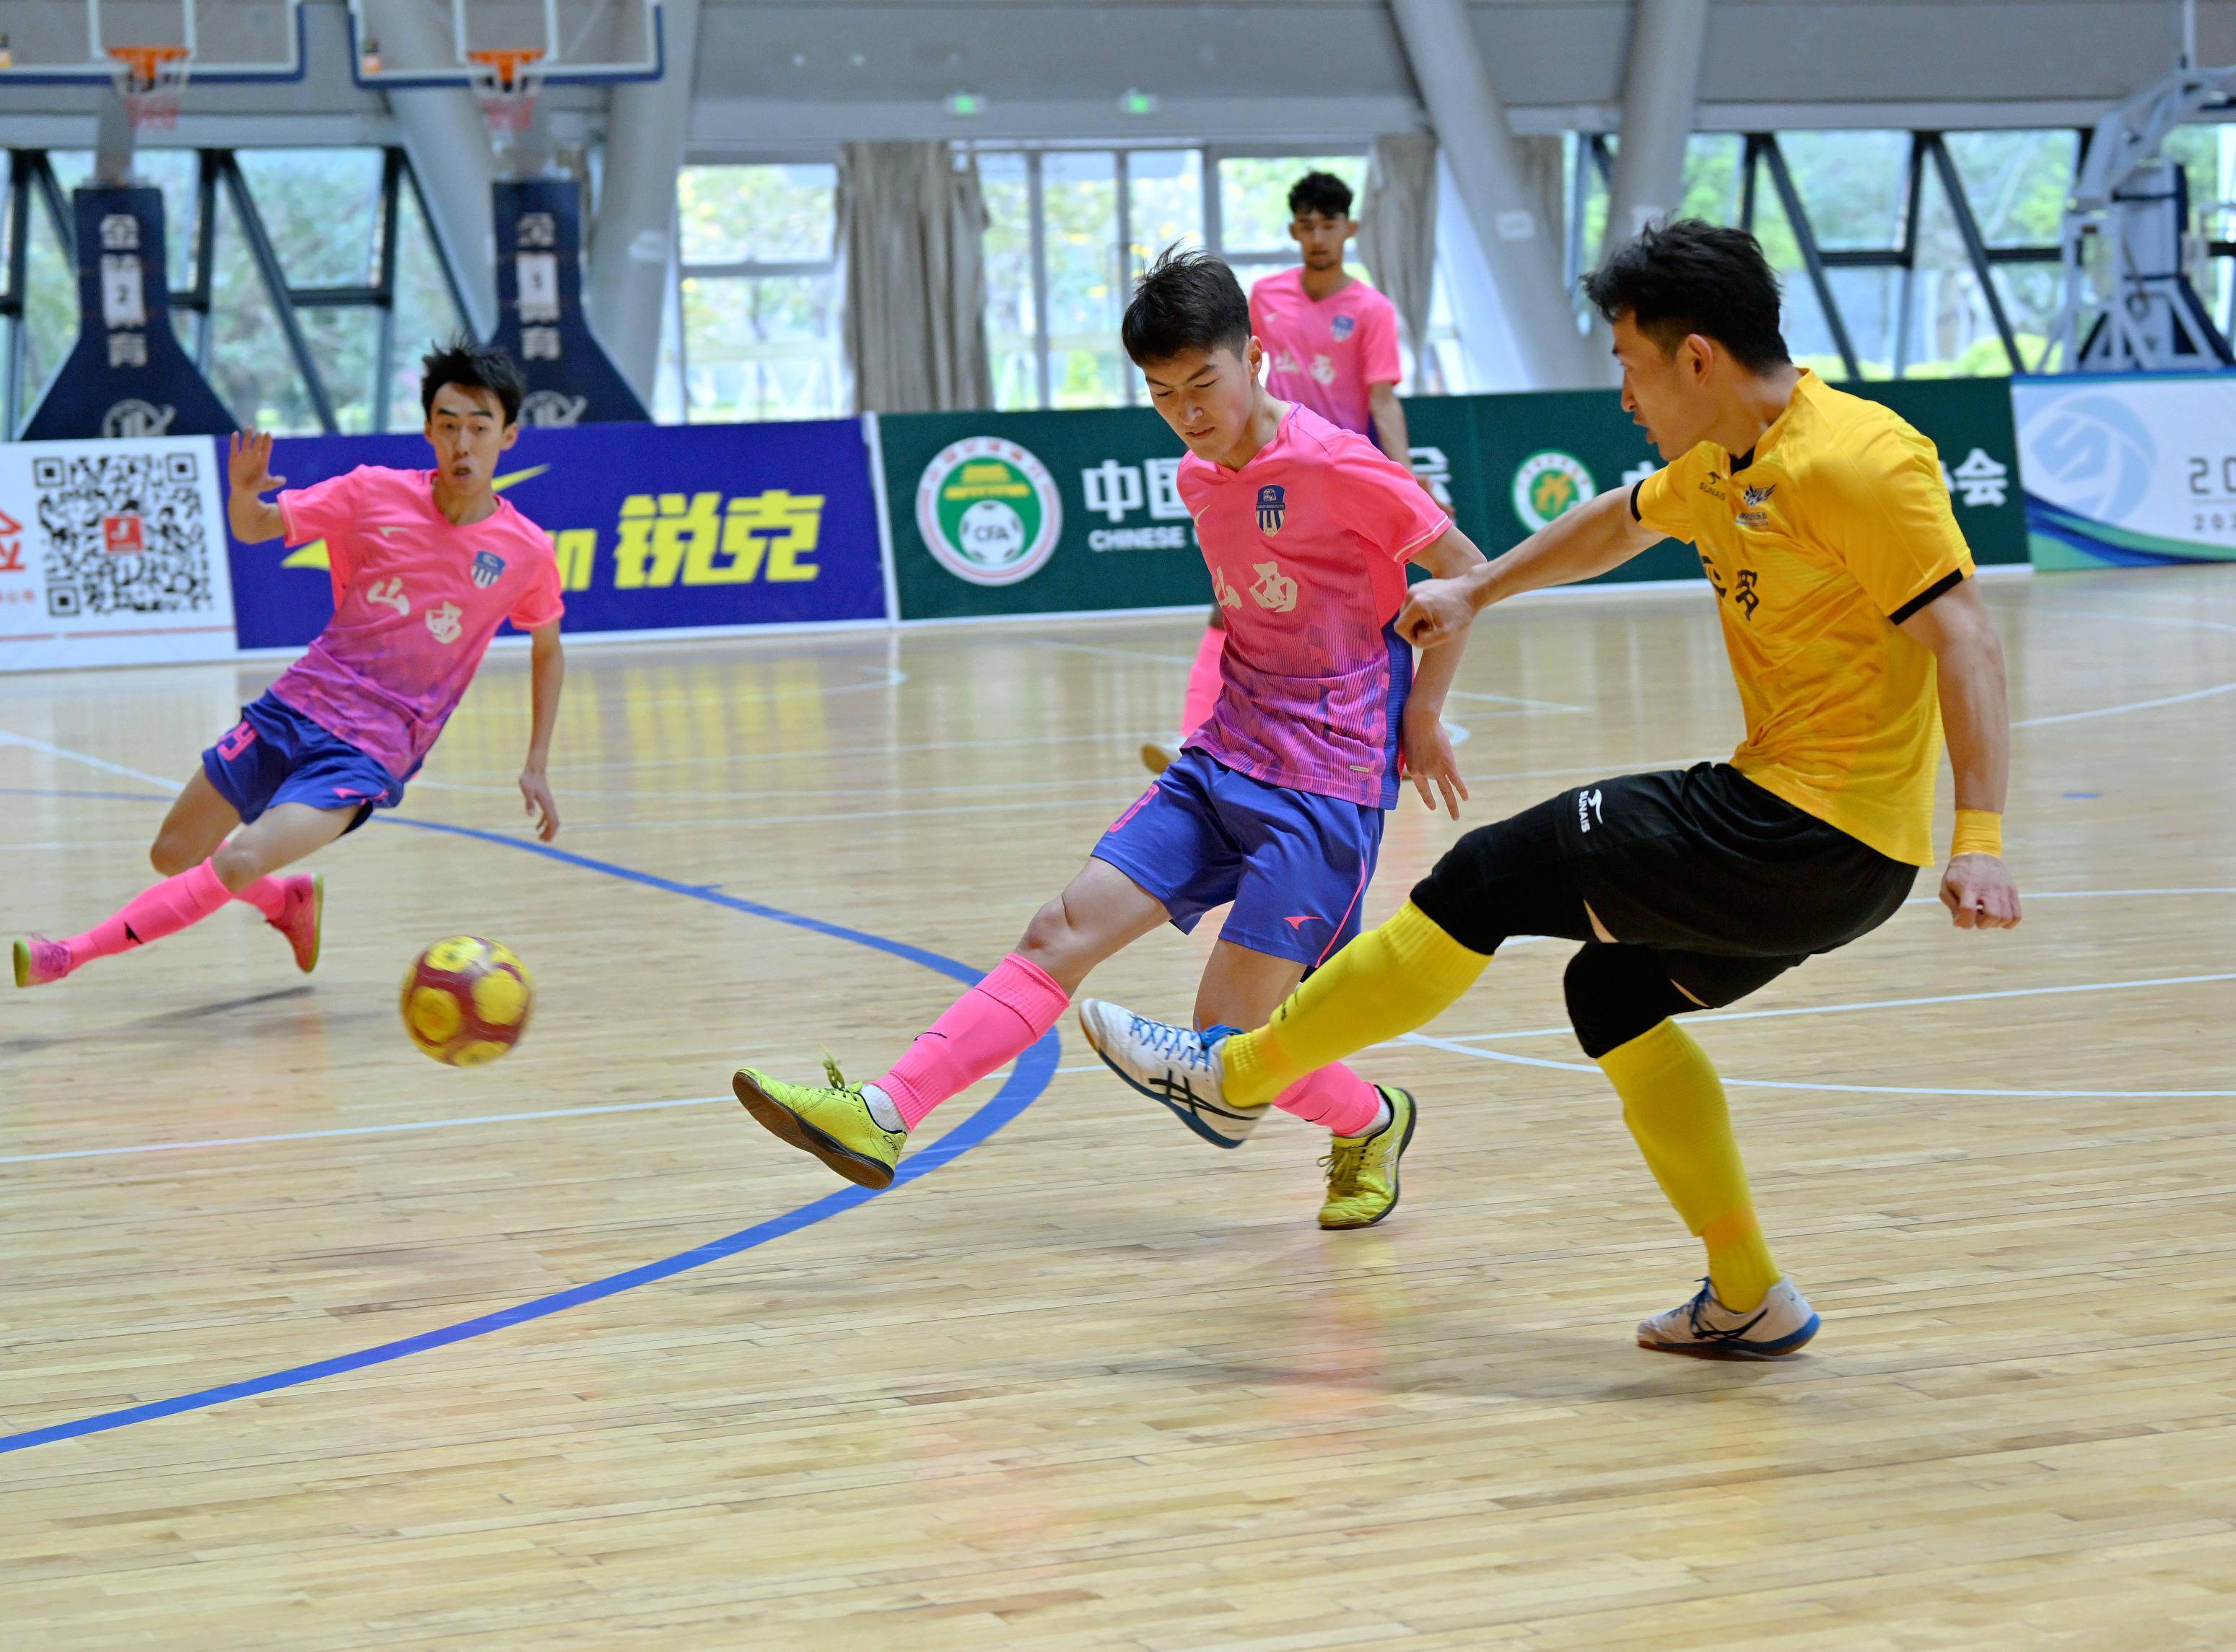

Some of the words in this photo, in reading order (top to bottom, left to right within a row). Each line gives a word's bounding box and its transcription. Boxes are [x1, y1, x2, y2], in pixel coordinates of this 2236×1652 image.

[614, 489, 824, 589] 锐克
[974, 526, 1010, 541] CFA
[1088, 526, 1186, 551] CHINESE
[367, 577, 463, 644] 山西
[1215, 561, 1298, 613] 山西
